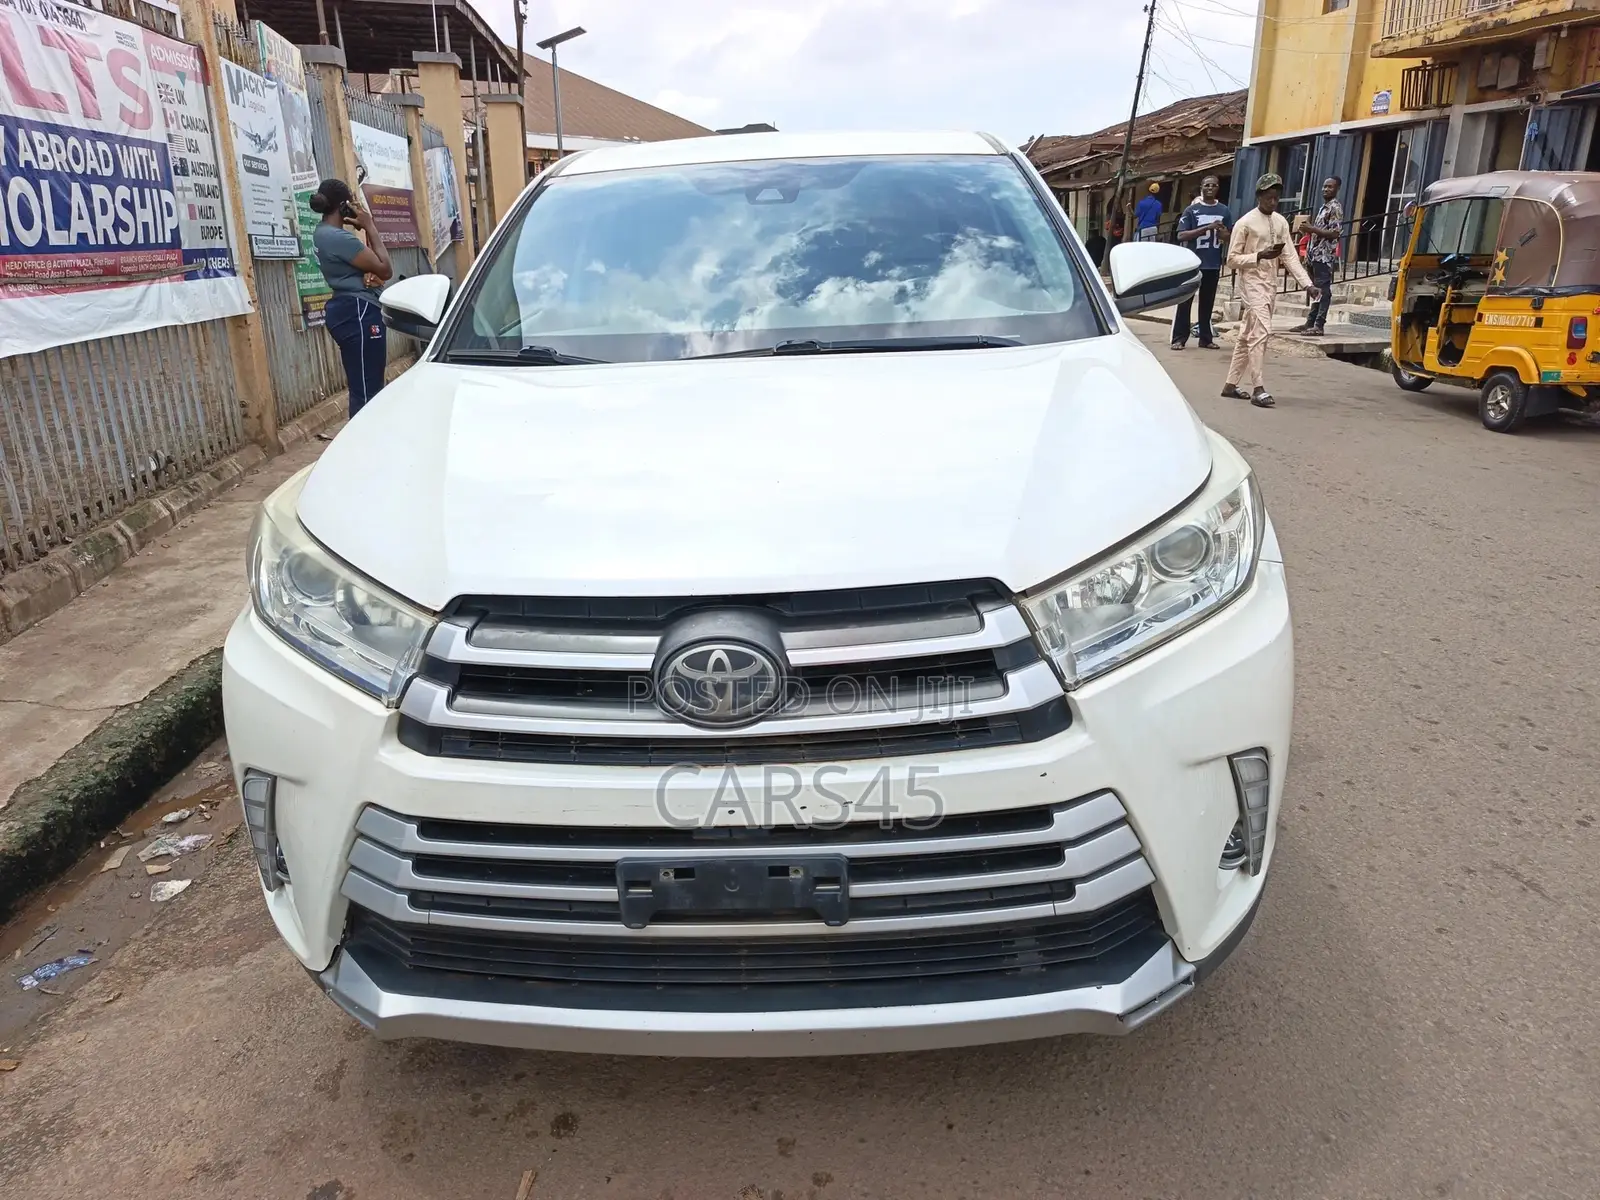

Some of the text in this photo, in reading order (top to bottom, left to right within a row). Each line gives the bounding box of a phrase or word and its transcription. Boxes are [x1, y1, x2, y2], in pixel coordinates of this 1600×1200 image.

[225, 64, 266, 108] MACKY
[174, 88, 187, 106] UK
[180, 114, 209, 134] CANADA
[185, 138, 200, 154] USA
[18, 128, 114, 176] ABROAD
[116, 143, 161, 182] WITH
[251, 160, 268, 172] services
[193, 182, 220, 199] FINLAND
[197, 204, 216, 220] MALTA
[200, 225, 223, 240] EUROPE
[5, 261, 23, 270] HEAD
[52, 259, 76, 269] ACTIVITY
[35, 271, 49, 279] Road
